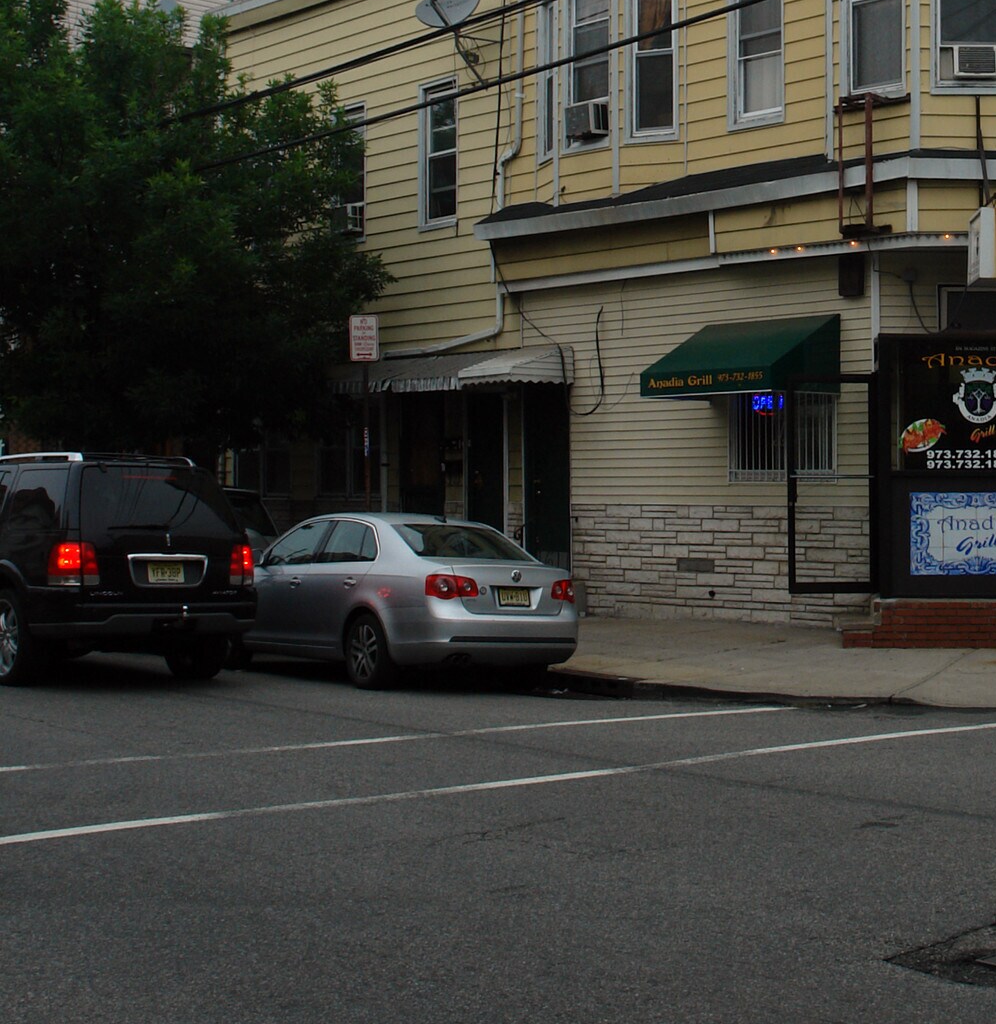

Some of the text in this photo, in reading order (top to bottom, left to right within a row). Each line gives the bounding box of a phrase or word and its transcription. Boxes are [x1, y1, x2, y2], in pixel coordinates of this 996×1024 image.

[648, 378, 685, 389] Anadia
[687, 374, 713, 387] Grill
[967, 414, 993, 422] ANADIA
[970, 424, 996, 443] Grill
